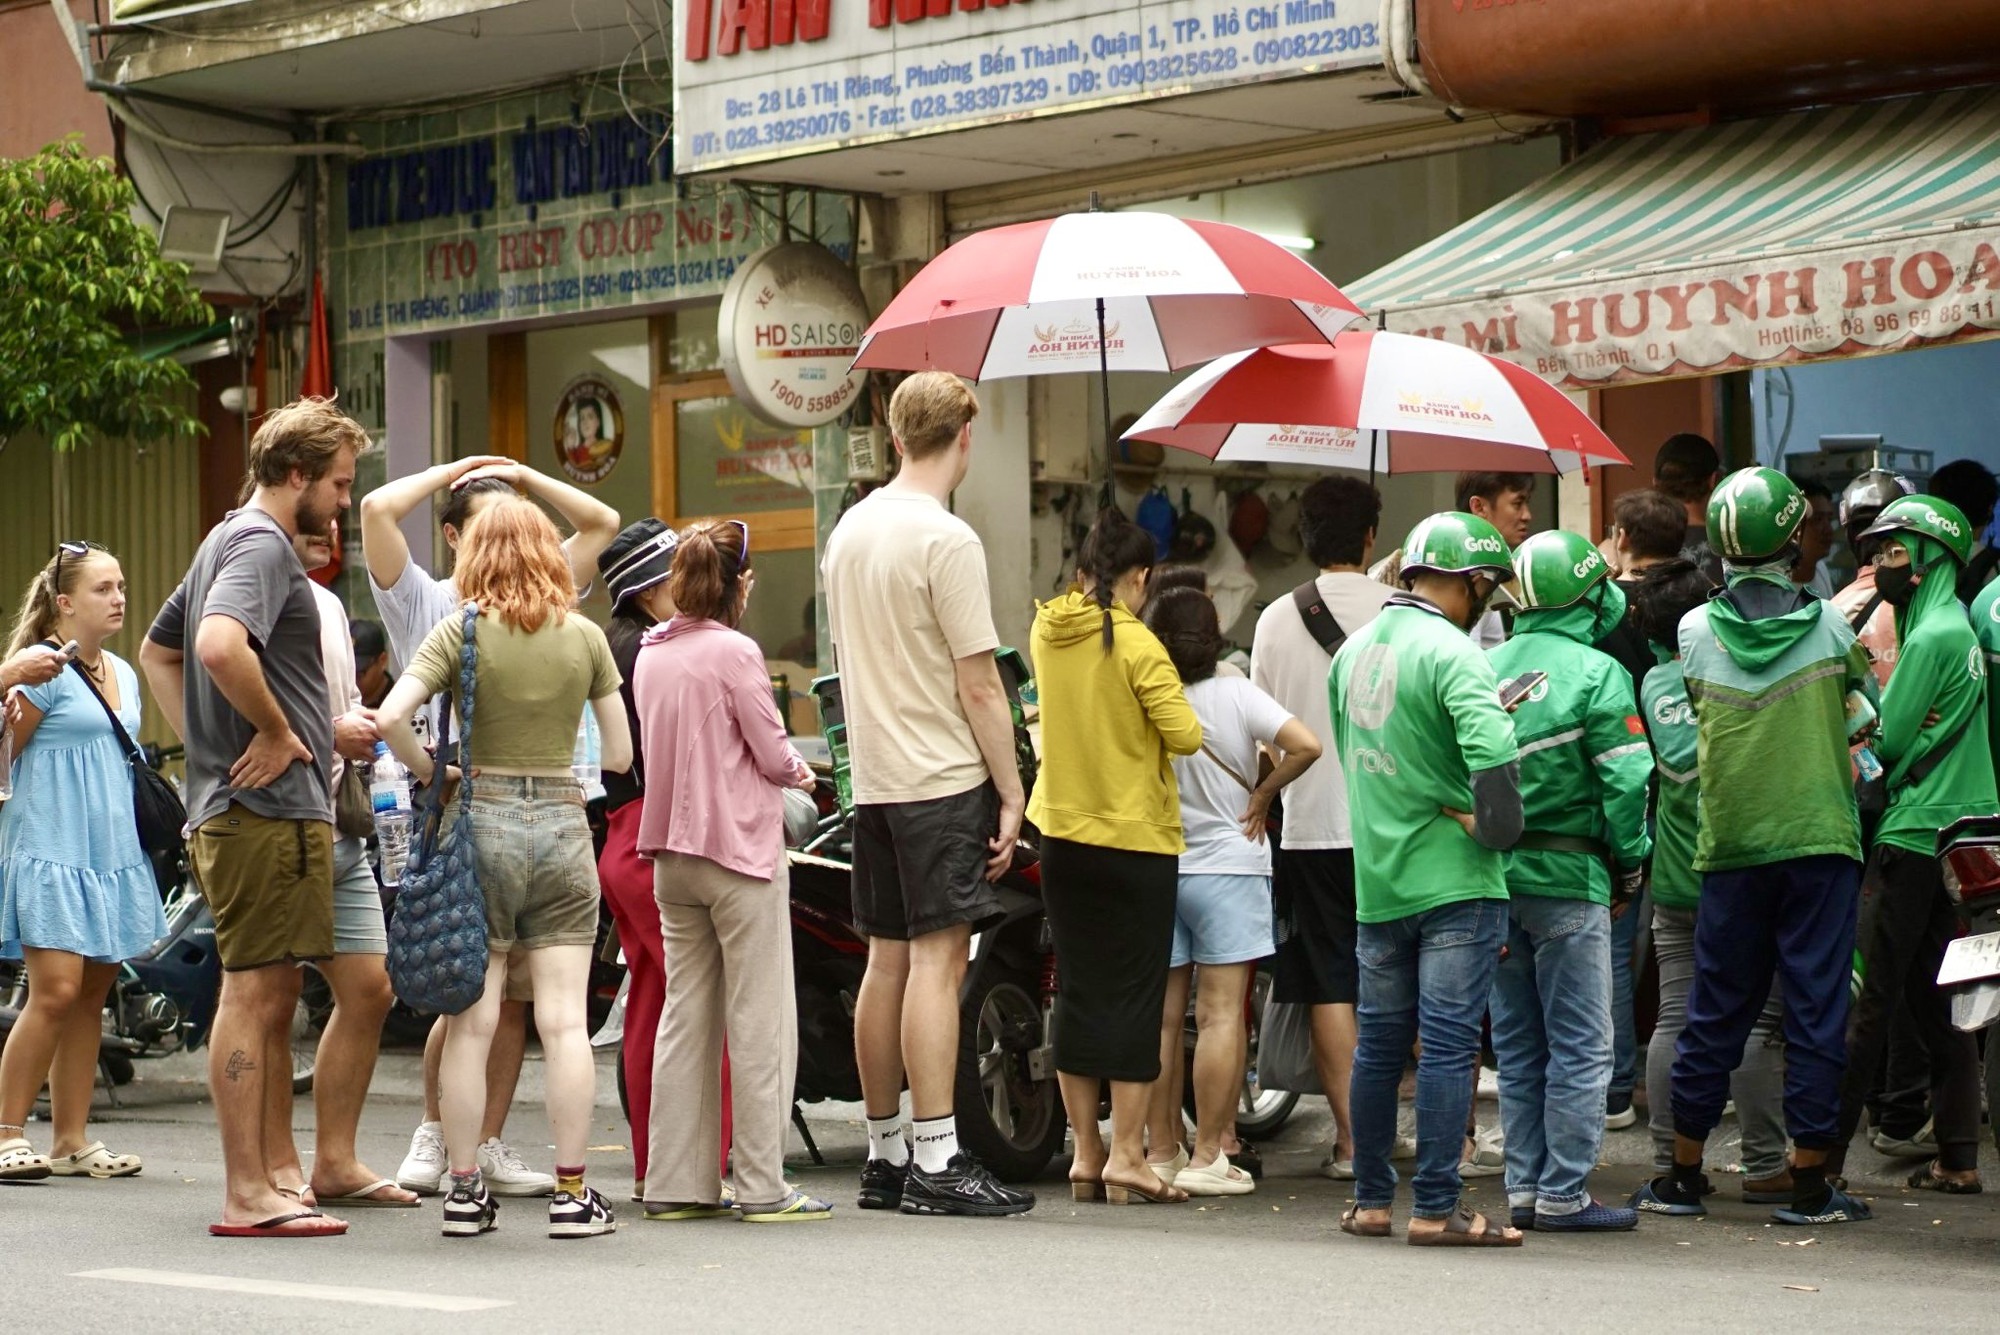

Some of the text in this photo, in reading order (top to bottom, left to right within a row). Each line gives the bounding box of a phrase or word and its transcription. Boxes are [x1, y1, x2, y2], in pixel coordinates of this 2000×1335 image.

[757, 93, 781, 115] 28
[786, 87, 806, 110] Lê
[811, 81, 839, 109] Thị
[844, 72, 901, 100] Riêng,
[905, 58, 974, 90] Phường
[980, 45, 1016, 74] Bến
[1021, 40, 1088, 70] Thành,
[1091, 31, 1141, 62] Quận
[1147, 25, 1167, 51] 1,
[1173, 17, 1206, 45] TP.
[1213, 8, 1241, 38] Hồ
[1245, 2, 1279, 33] Chí
[1285, 0, 1336, 26] Minh
[726, 112, 851, 151] 028.39250076
[868, 104, 906, 128] Fax:
[910, 78, 1049, 121] 028.38397329
[1067, 70, 1101, 94] DĐ:
[1107, 46, 1238, 88] 0903825628
[500, 226, 566, 274] RIST
[675, 205, 713, 250] No
[755, 286, 776, 310] XE
[1549, 241, 2000, 347] HUYNH HOA
[1758, 324, 1832, 346] Hotline:
[1874, 312, 1900, 333] 96
[1907, 308, 1932, 328] 69
[1939, 304, 1963, 324] 88
[1537, 353, 1568, 375] Bến
[1574, 345, 1638, 370] Thành,
[770, 377, 856, 414] 1900 558854
[1398, 403, 1455, 418] HUYNH
[1459, 410, 1494, 422] HOA
[1775, 494, 1801, 528] Grab
[1923, 509, 1962, 538] Grab
[1464, 535, 1503, 553] Grab
[1573, 549, 1601, 579] Grab
[1653, 695, 1699, 725] Gra
[194, 927, 215, 935] HON
[914, 1130, 955, 1143] Kappa
